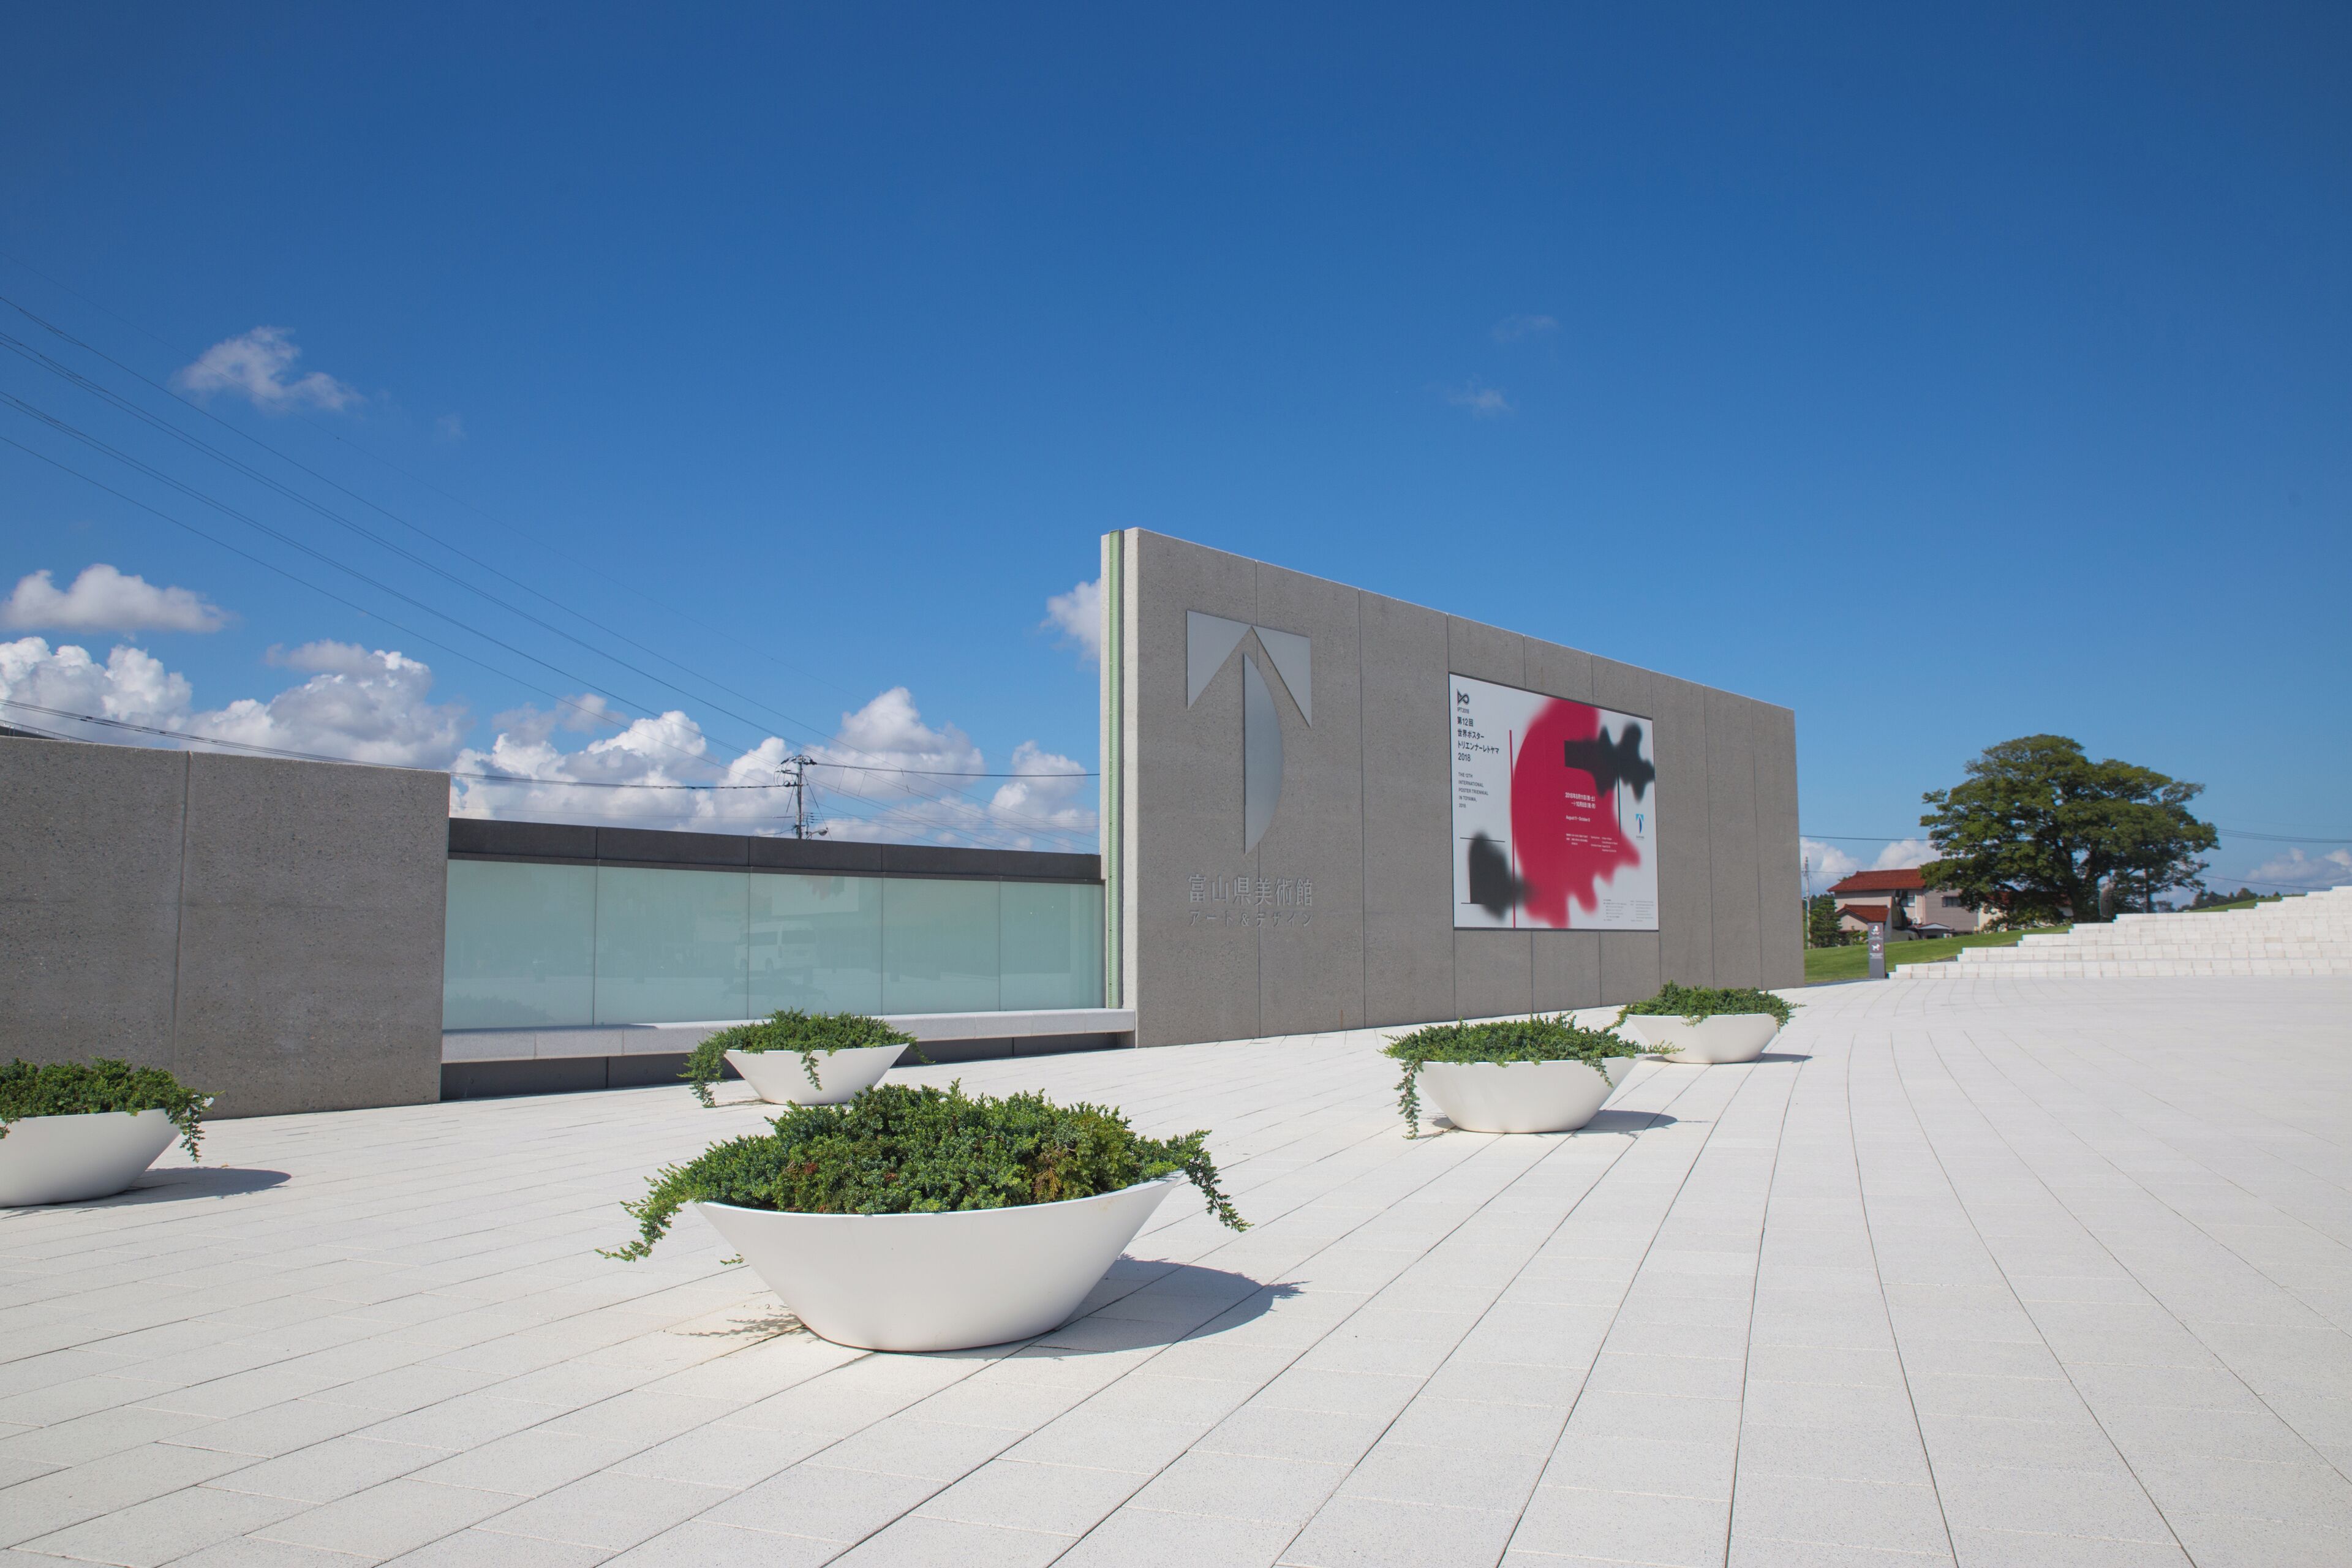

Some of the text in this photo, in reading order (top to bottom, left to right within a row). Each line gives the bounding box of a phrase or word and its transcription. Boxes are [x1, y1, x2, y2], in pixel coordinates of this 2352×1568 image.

[1457, 716, 1474, 727] 第12回
[1457, 728, 1485, 740] 世界ポスター
[1458, 740, 1499, 754] トリエンナーレトヤマ
[1458, 752, 1471, 761] 2018
[1187, 873, 1313, 907] 富山県美術館
